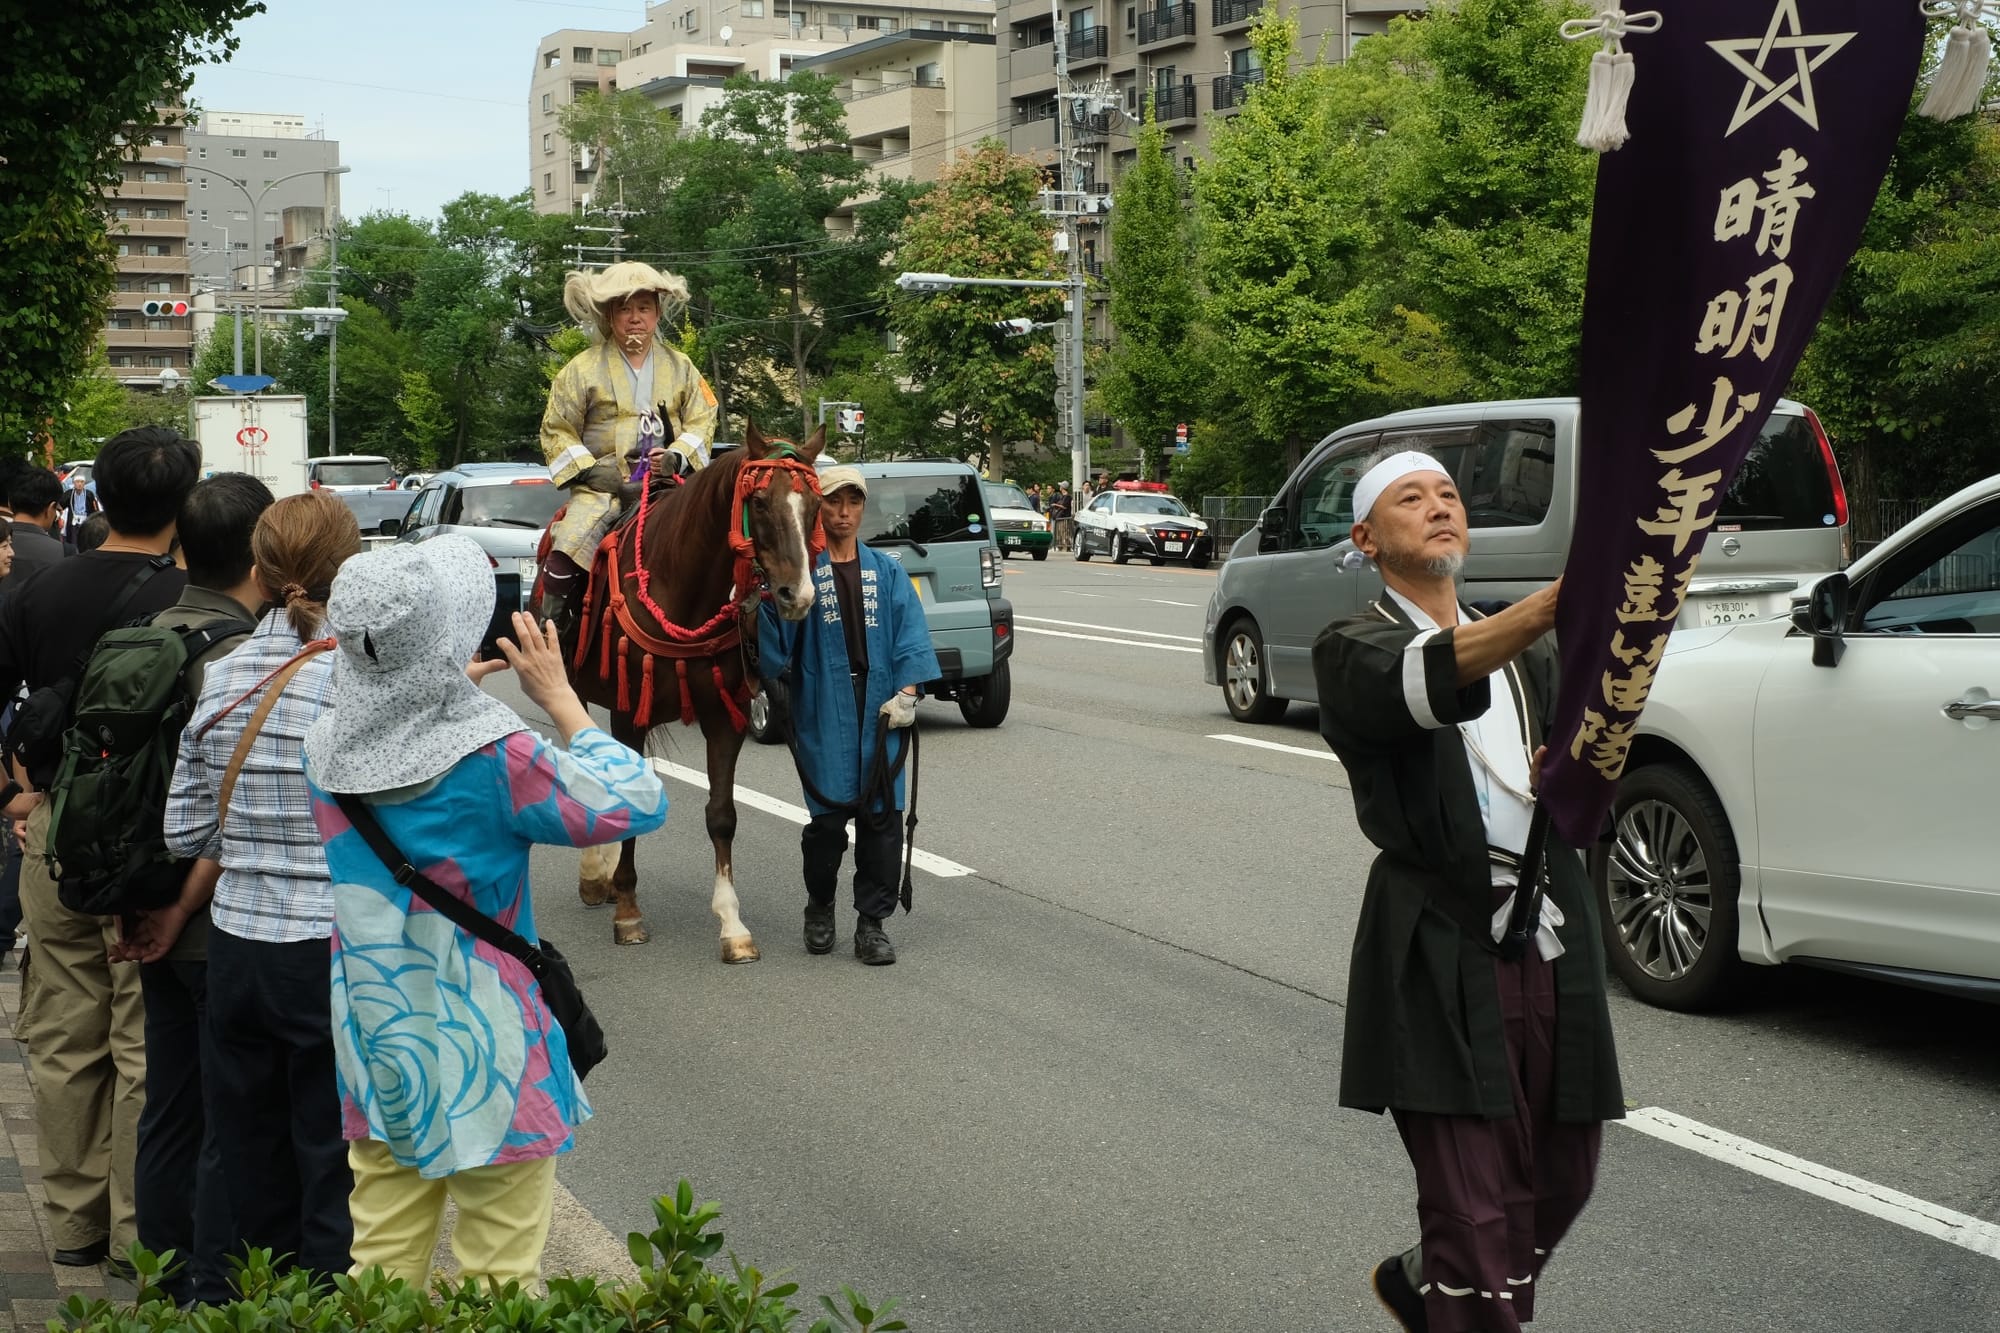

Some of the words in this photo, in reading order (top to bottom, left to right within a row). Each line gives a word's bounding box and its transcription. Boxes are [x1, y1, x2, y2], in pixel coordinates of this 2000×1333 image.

[816, 564, 841, 625] 晴明神社
[860, 569, 879, 628] 晴明神社
